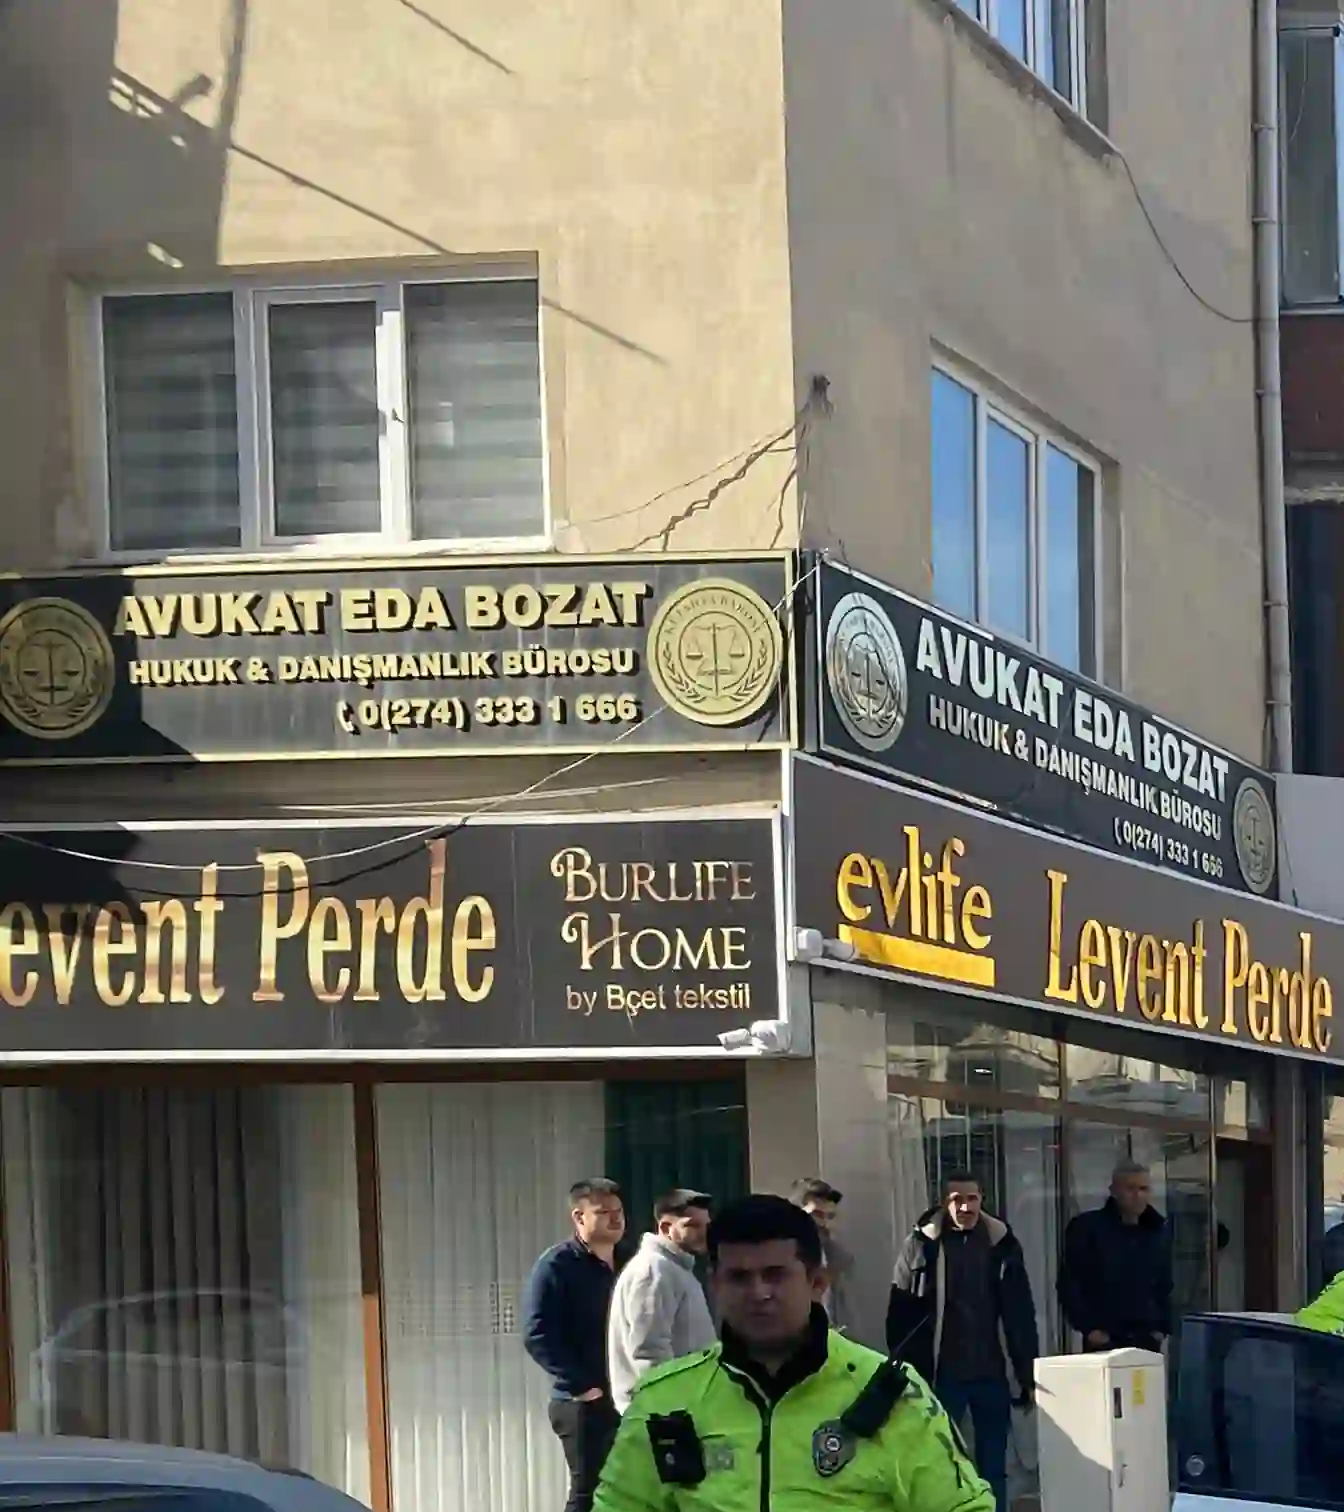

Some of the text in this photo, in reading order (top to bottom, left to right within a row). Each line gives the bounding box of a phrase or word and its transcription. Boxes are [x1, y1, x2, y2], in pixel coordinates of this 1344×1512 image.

[113, 590, 328, 637] AVUKAT
[341, 586, 452, 631] EDA
[464, 581, 648, 628] BOZAT
[128, 643, 635, 688] HUKUK & DANIŞMANLIK BÜROSU
[475, 695, 537, 724] 333
[547, 695, 562, 721] 1
[576, 692, 639, 722] 666
[916, 617, 1064, 728] AVUKAT
[1072, 686, 1136, 762] EDA
[1142, 719, 1230, 804] BOZAT
[929, 694, 1222, 842] HUKUK & DANIŞMANLIK BÜROSU
[836, 825, 993, 951] evlife
[1167, 838, 1190, 867] 333
[1201, 850, 1225, 879] 666
[252, 837, 497, 1005] Perde
[1043, 868, 1333, 1054] Levent Perde
[566, 984, 598, 1016] by
[674, 982, 751, 1010] tekstil
